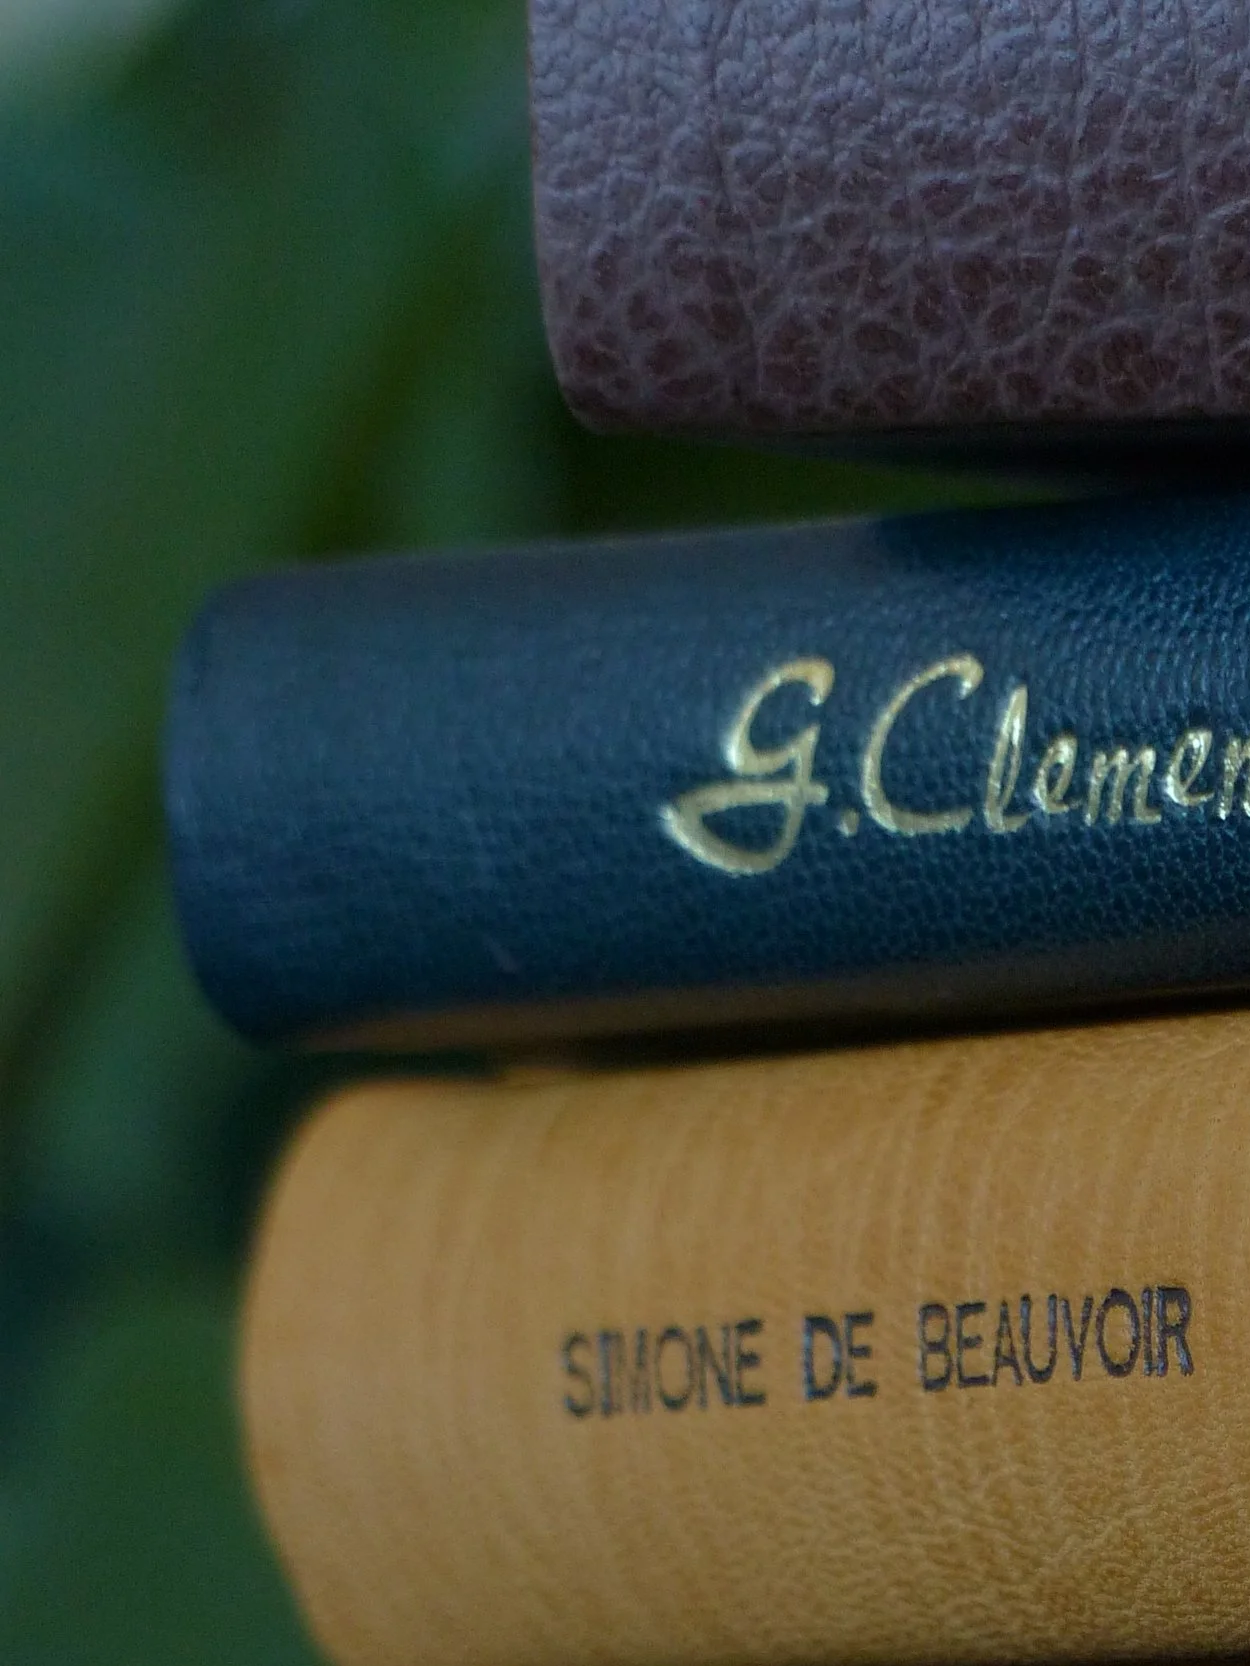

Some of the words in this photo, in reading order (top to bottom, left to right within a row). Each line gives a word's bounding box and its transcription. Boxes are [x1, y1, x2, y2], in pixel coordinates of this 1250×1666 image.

[561, 1317, 769, 1420] SIMONE
[804, 1310, 878, 1401] DE
[917, 1284, 1195, 1393] BEAUVOIR
